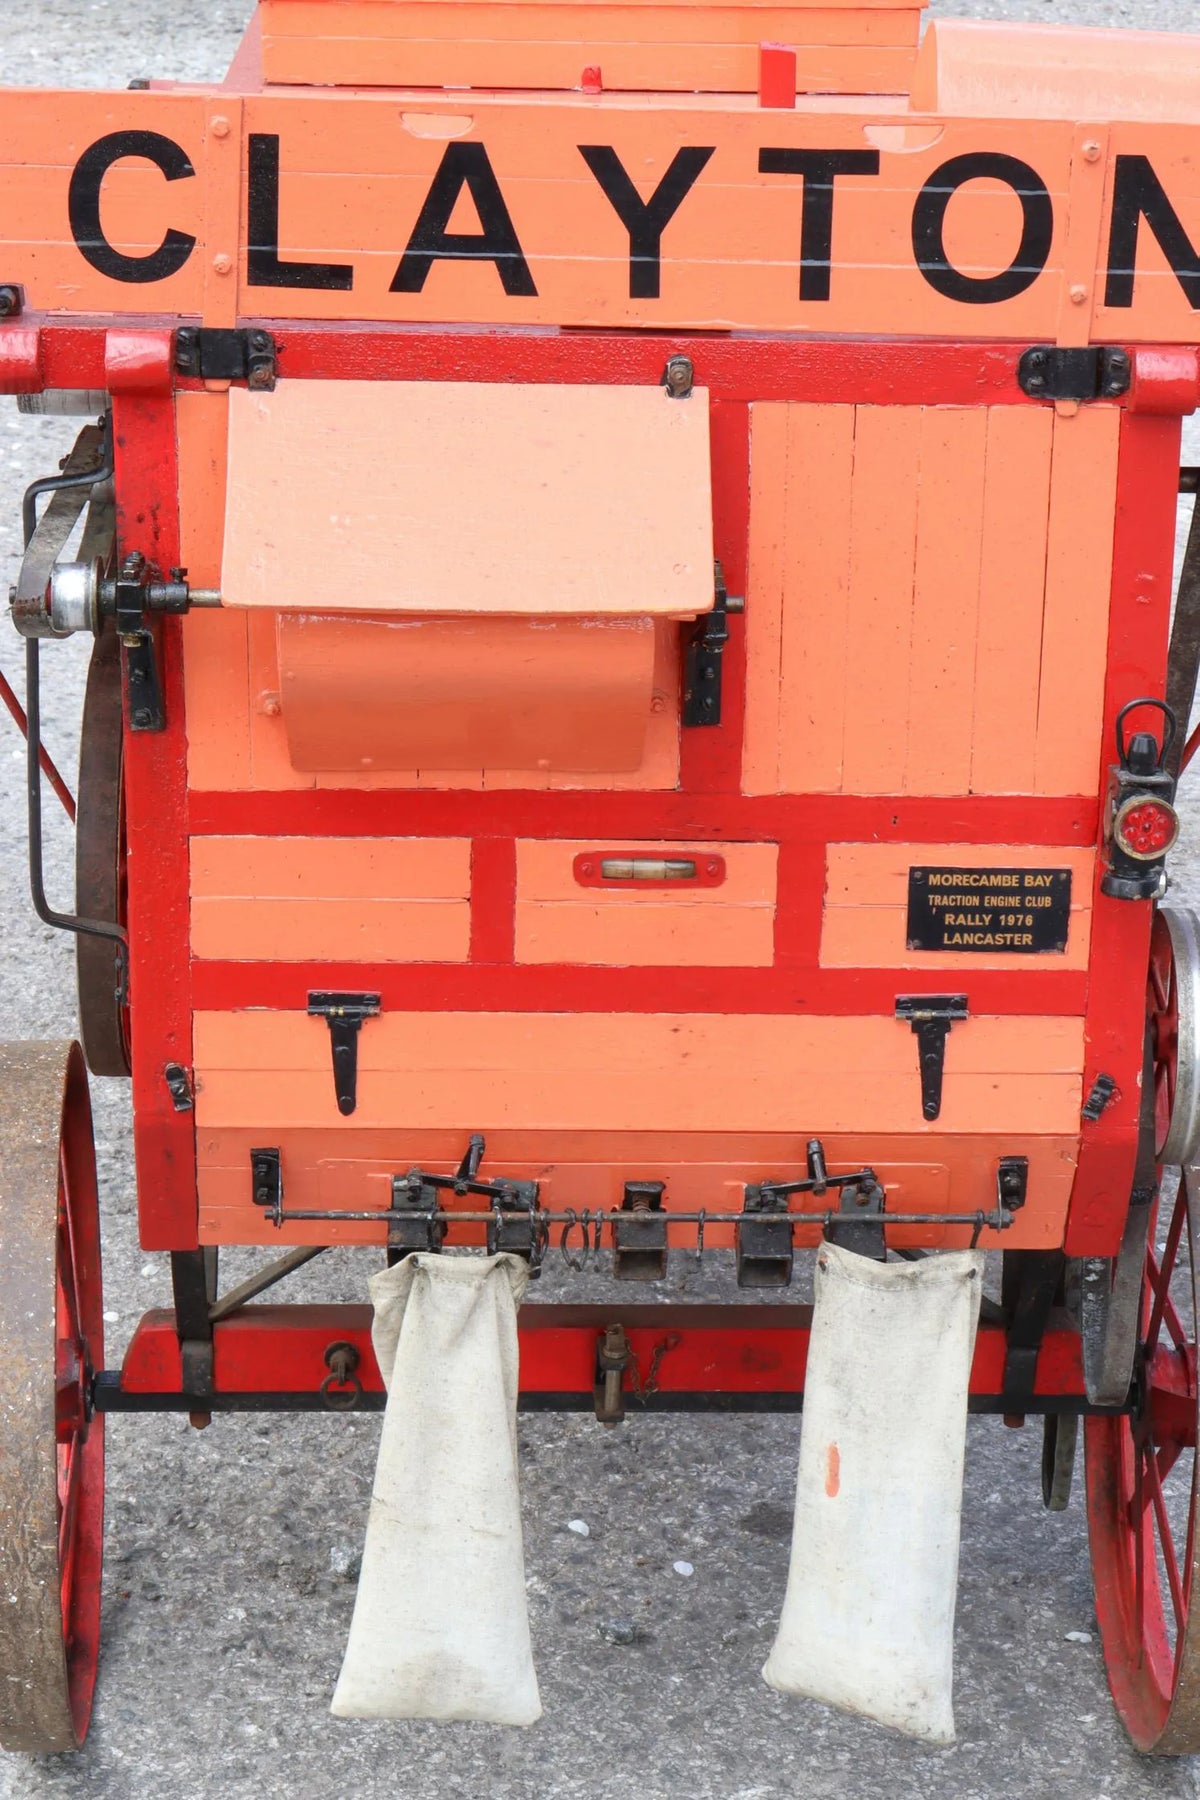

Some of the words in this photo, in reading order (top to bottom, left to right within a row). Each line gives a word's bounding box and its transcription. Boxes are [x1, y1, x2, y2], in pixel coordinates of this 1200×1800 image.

[68, 129, 1200, 308] CLAYTON
[928, 874, 1019, 887] MORECAMBE
[1024, 875, 1053, 887] BAY
[928, 895, 980, 906] TRACTION
[984, 895, 1021, 907] ENGINE
[1025, 896, 1052, 907] CLUB
[944, 914, 992, 925] RALLY
[999, 915, 1033, 926] 1976
[943, 932, 1032, 945] LANCASTER
